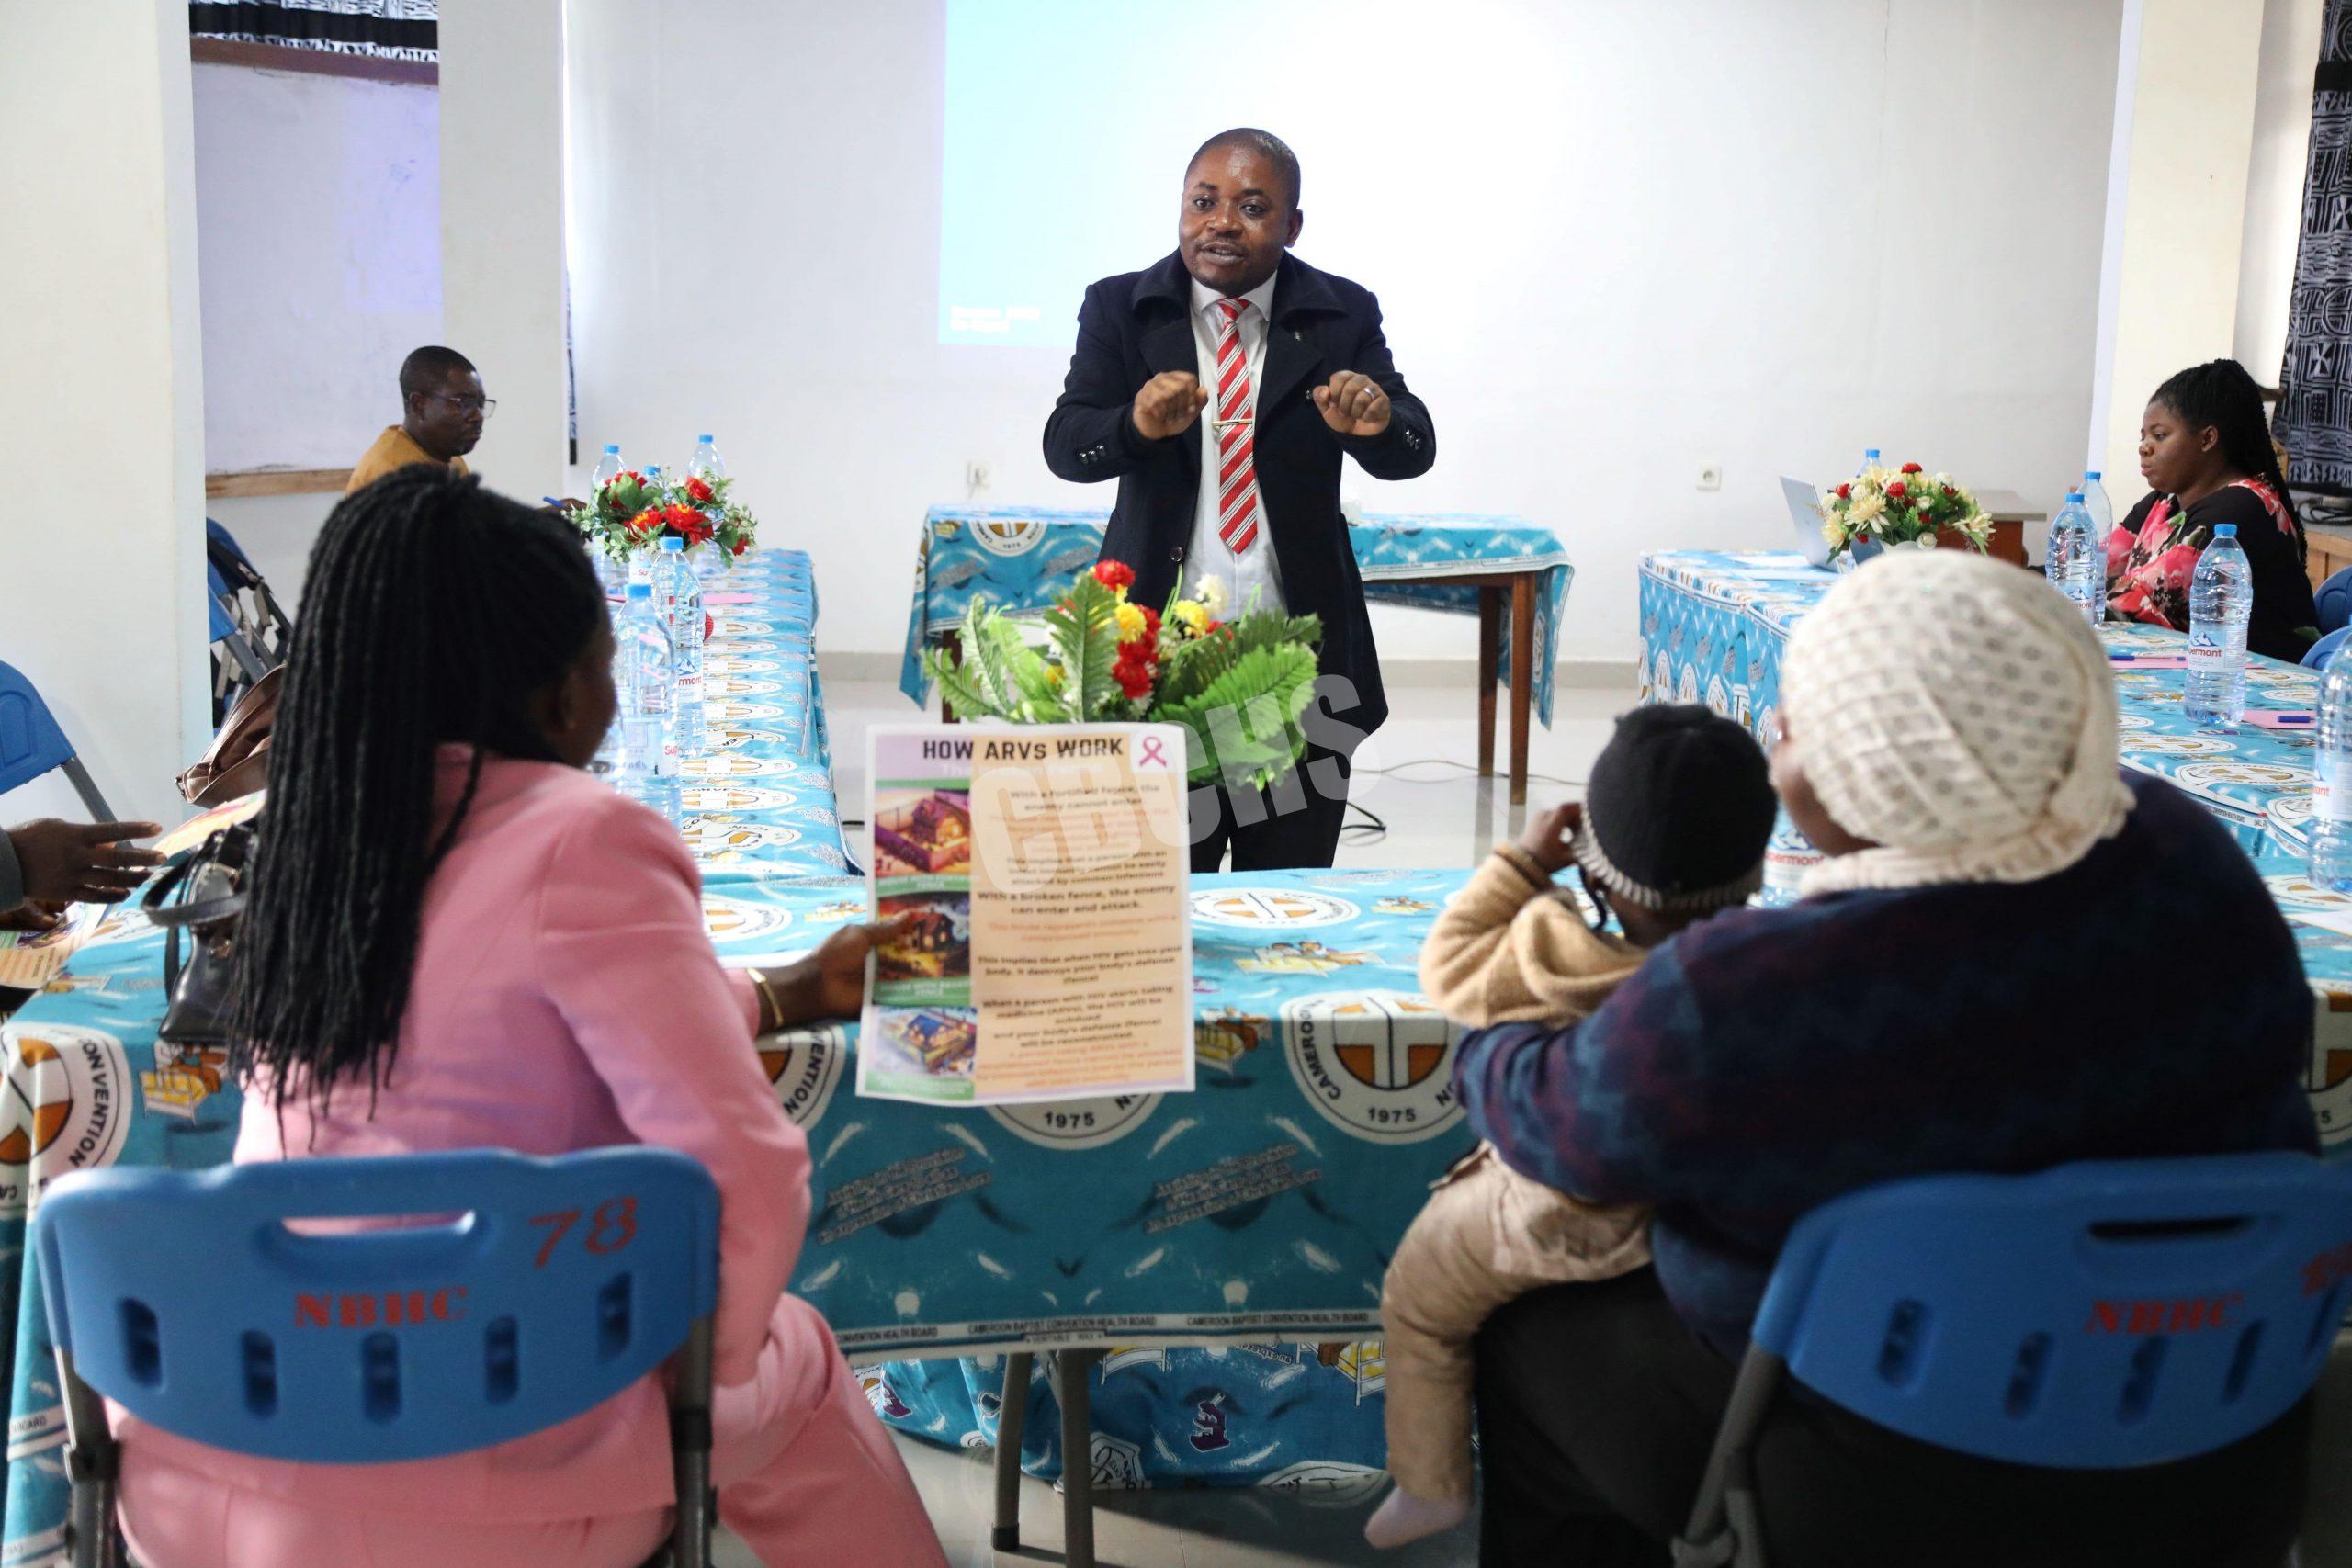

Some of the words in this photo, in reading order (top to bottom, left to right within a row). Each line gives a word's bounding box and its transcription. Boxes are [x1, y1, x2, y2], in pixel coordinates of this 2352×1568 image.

[923, 740, 974, 759] HOW
[985, 740, 1046, 760] ARVs
[1057, 738, 1124, 758] WORK
[1045, 1111, 1095, 1129] 1975
[1368, 1107, 1417, 1124] 1975
[529, 1197, 638, 1269] 78
[295, 1286, 468, 1328] NBHC
